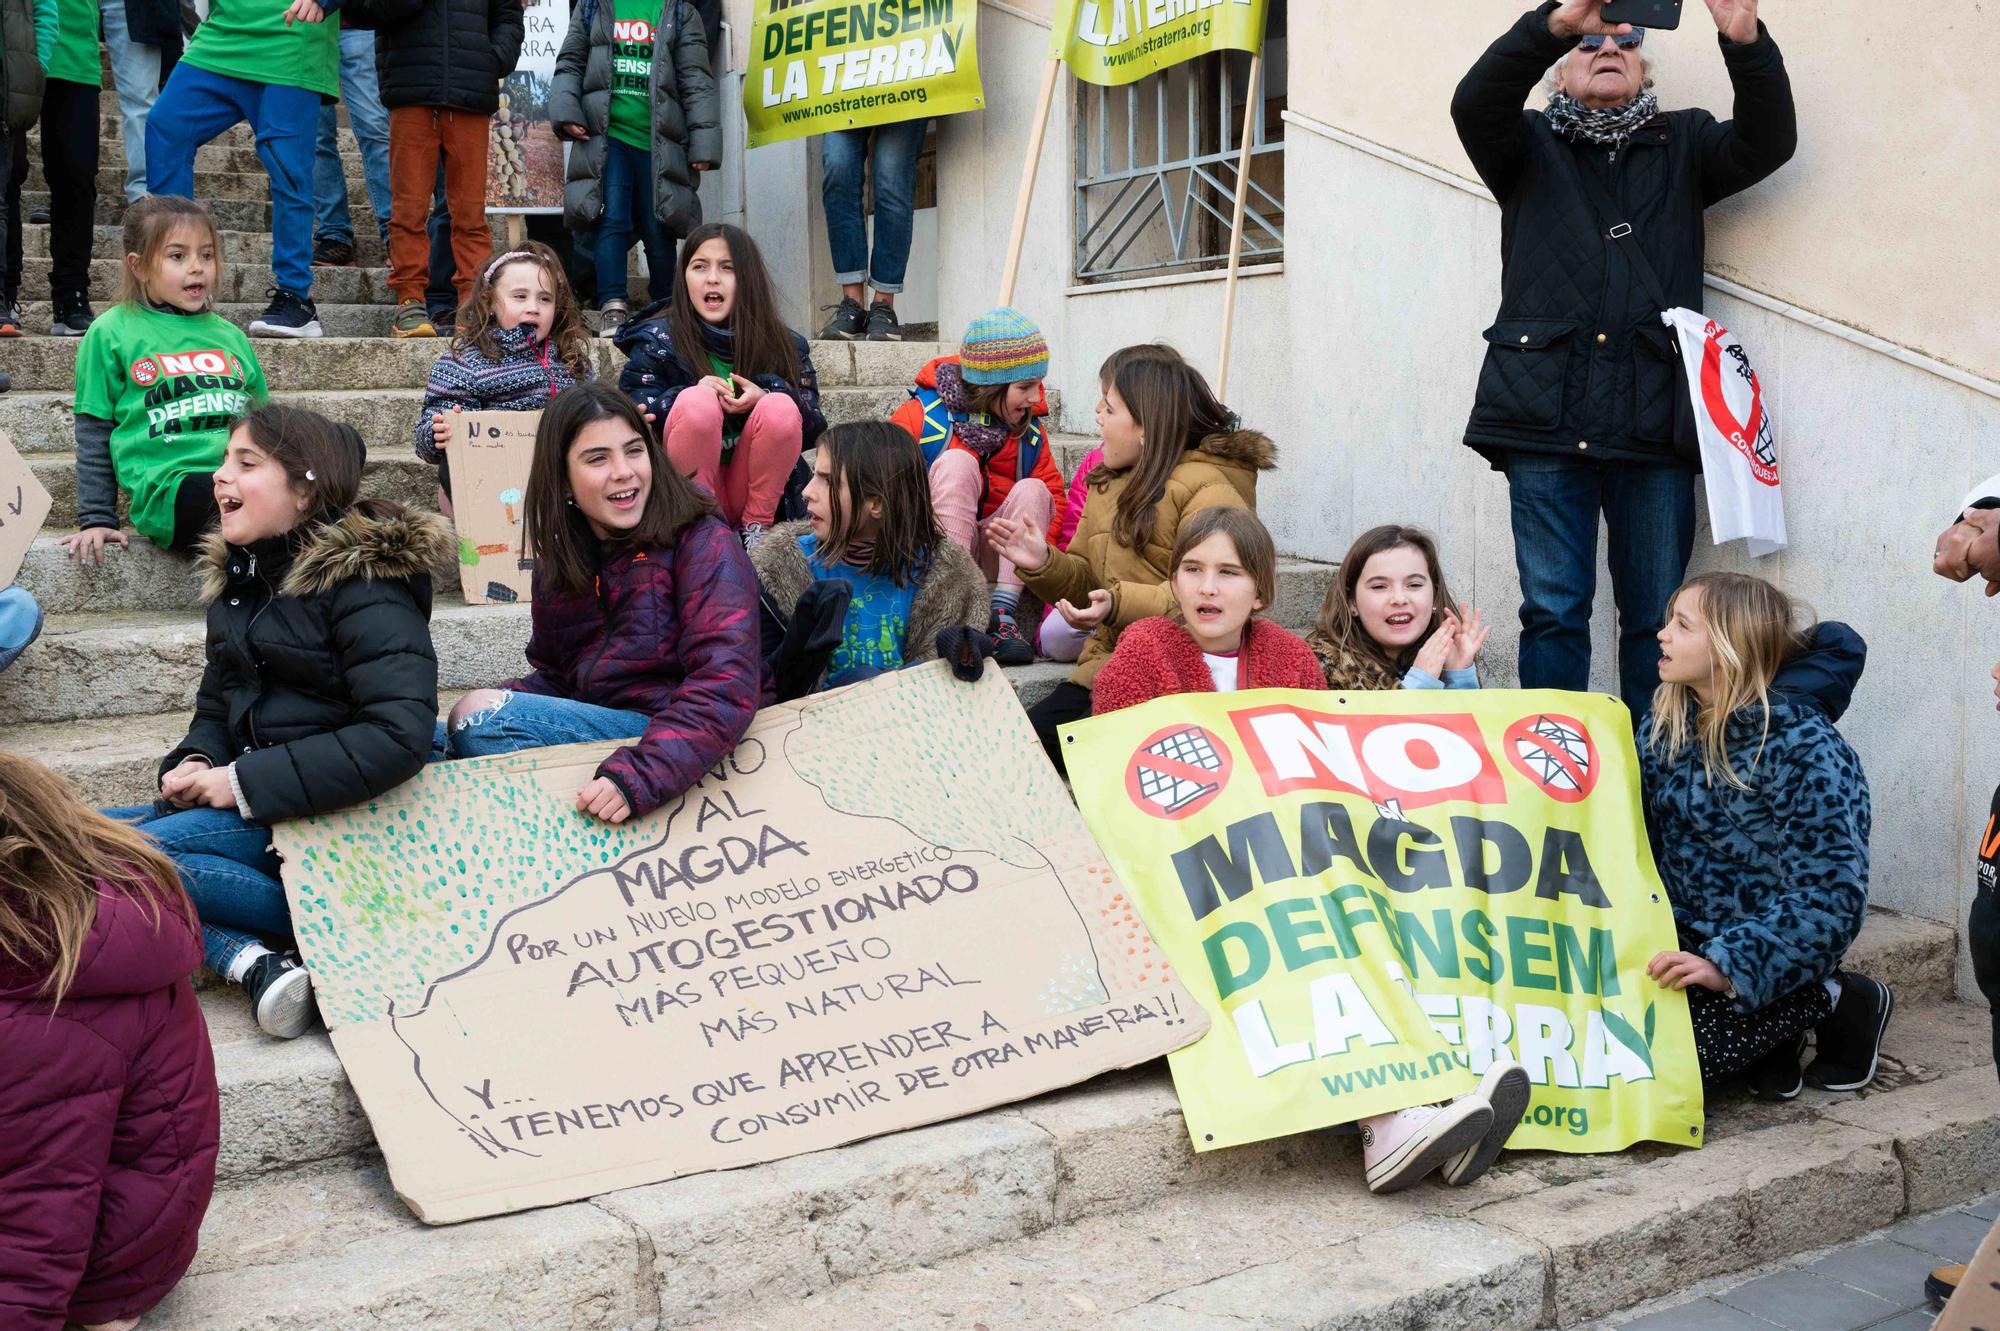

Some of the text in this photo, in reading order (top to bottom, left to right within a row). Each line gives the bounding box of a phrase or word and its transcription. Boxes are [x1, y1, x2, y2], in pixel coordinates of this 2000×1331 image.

[613, 22, 649, 40] NO
[762, 0, 953, 61] DEFENSEM
[1103, 18, 1211, 67] www.nstraterra.org
[762, 31, 956, 109] LA TERRA
[782, 87, 927, 124] www.nostraterra.org
[159, 352, 226, 373] NO
[146, 392, 253, 426] DEFENSE
[148, 418, 182, 440] LA
[1247, 711, 1484, 796] NO
[696, 789, 767, 832] AL
[612, 824, 810, 907] MAGDA
[1170, 801, 1613, 922] MAGDA
[566, 864, 979, 998] AUTOGESTIONADO
[573, 926, 617, 949] UN
[626, 901, 717, 937] NUEVO
[724, 877, 821, 914] MODELO
[1202, 884, 1622, 1001] DEFENSEM
[708, 937, 891, 998] PEQUEÑO
[700, 962, 982, 1047] MÁS NATURAL
[1231, 973, 1398, 1078] LA
[778, 1020, 971, 1089] APRENDER
[981, 1010, 1008, 1036] A
[898, 1065, 949, 1096] DE
[951, 1042, 1023, 1078] OTRA
